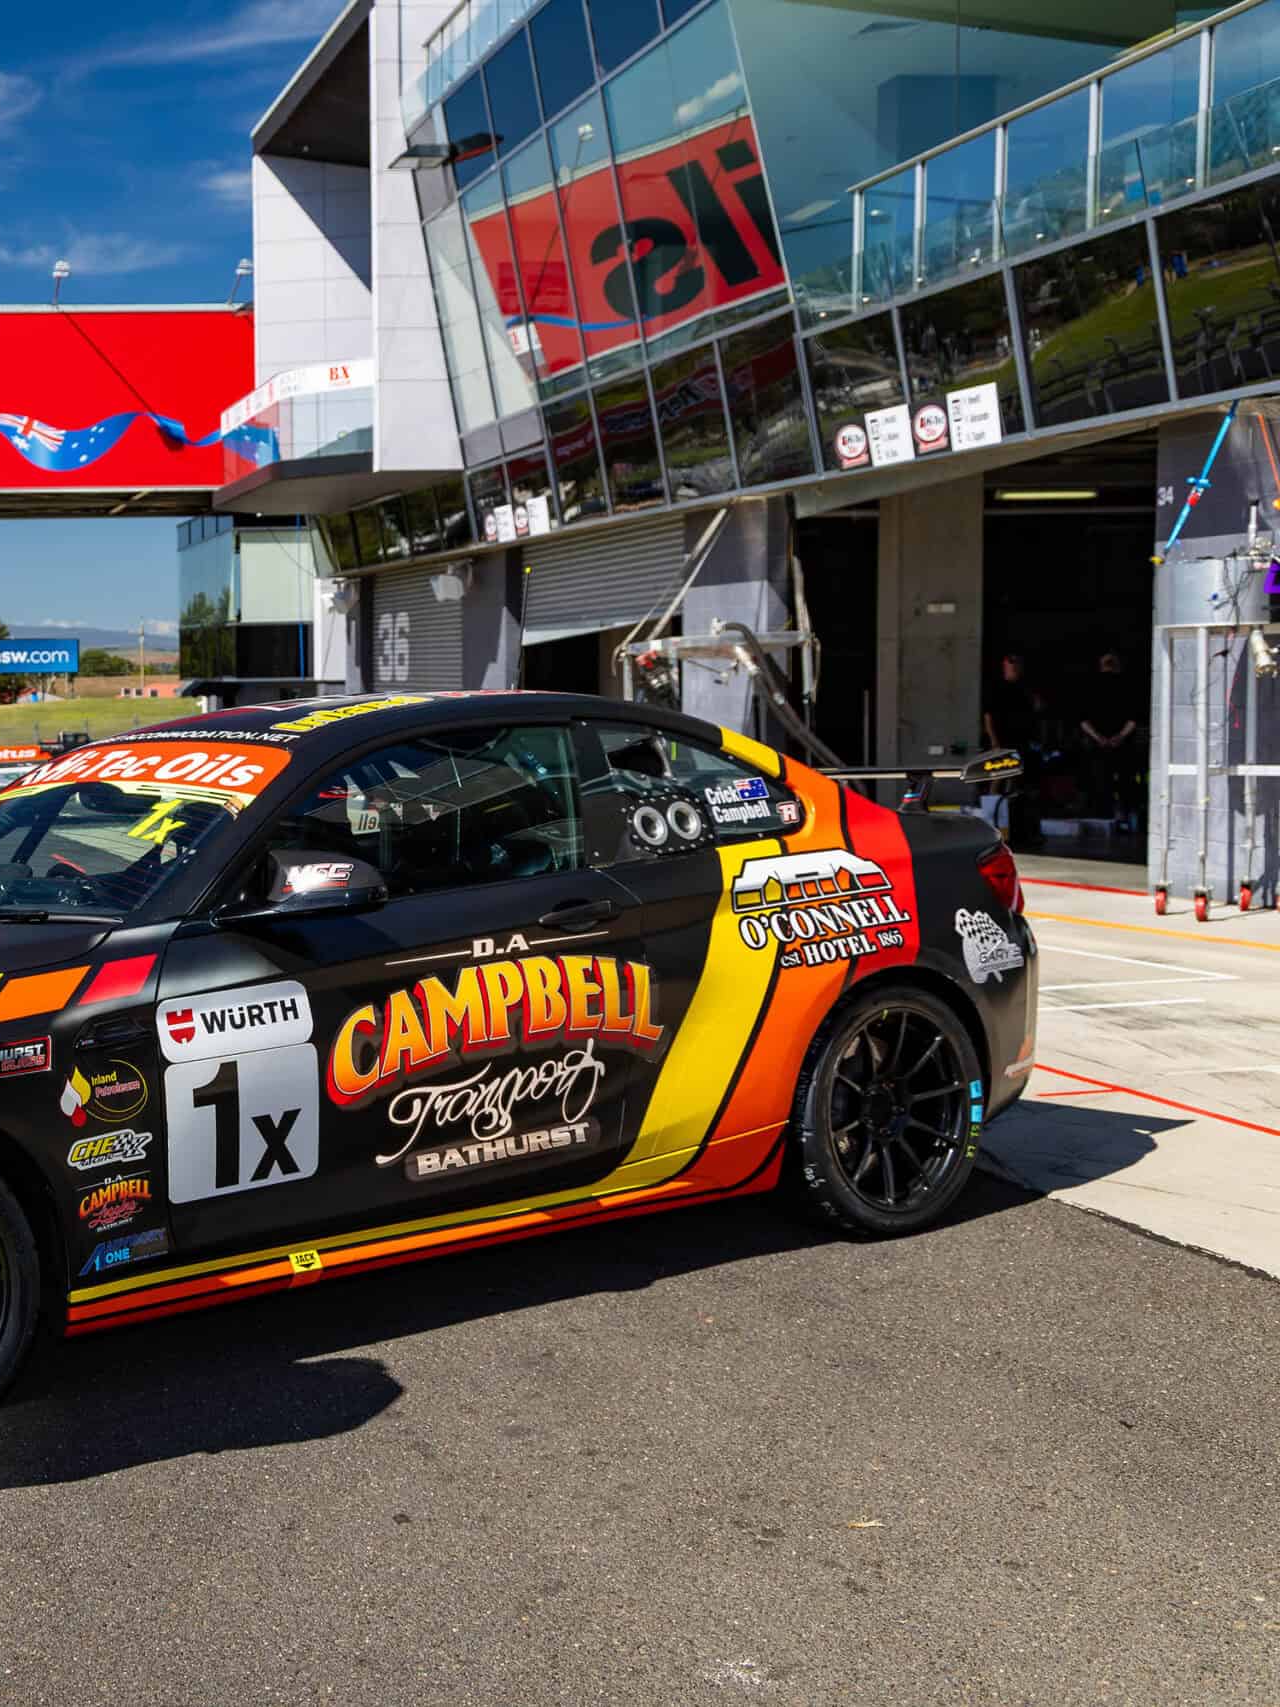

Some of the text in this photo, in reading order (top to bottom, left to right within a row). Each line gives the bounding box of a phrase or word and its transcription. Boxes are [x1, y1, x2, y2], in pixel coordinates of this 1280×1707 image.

[154, 752, 265, 787] Oils
[712, 799, 771, 824] Campbell
[740, 895, 911, 949] O'CONNELL
[472, 934, 531, 958] D.A
[803, 934, 877, 966] HOTEL
[877, 930, 904, 948] 1865
[326, 955, 665, 1106] CAMPBELL
[91, 1070, 117, 1086] Inland
[375, 1038, 605, 1164] Transport
[415, 1121, 591, 1176] BATHURST
[79, 1178, 153, 1220] CAMPBELL
[106, 1248, 130, 1263] ONE
[295, 1252, 315, 1265] JACK
